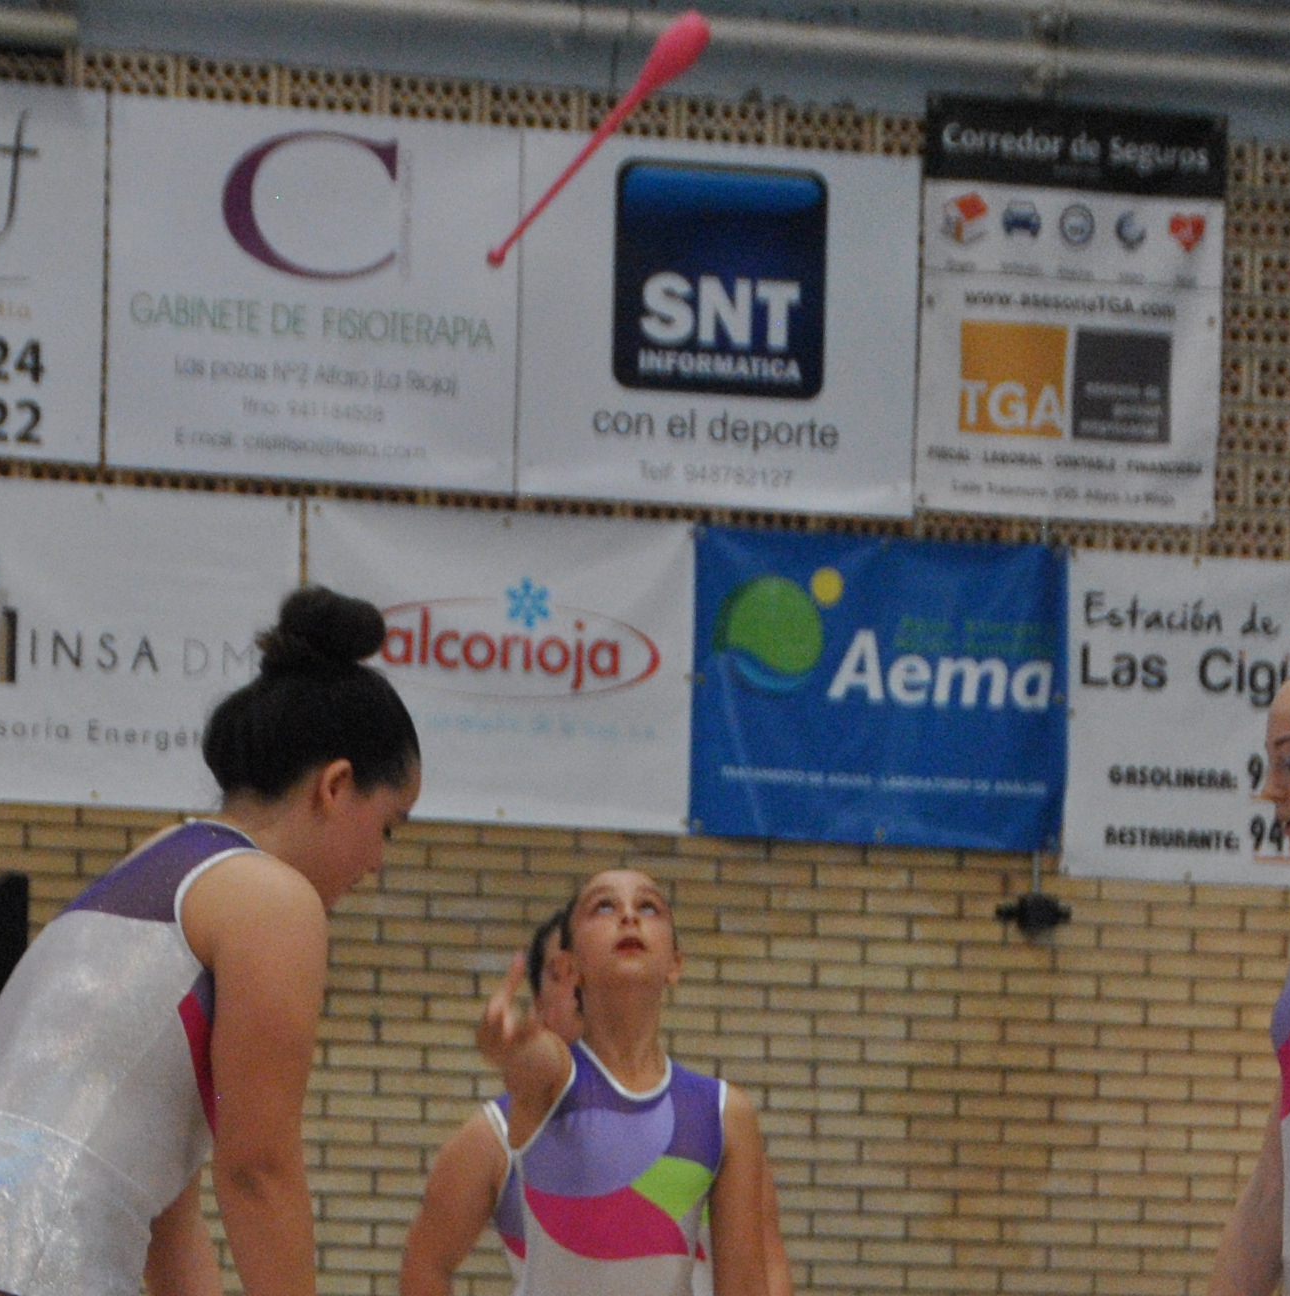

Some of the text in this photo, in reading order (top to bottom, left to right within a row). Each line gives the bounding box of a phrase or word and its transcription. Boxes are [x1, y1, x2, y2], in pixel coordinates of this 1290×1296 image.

[941, 121, 1209, 177] Corredor de Seguros
[129, 291, 494, 351] GABINETE DE FISIOTERAPIA
[639, 270, 802, 351] SNT
[637, 347, 803, 384] INFORMATICA
[959, 380, 1064, 428] TGA
[593, 407, 840, 451] con el deporte
[1084, 591, 1222, 633] Estación
[1241, 603, 1279, 637] de
[29, 628, 159, 674] INSA
[381, 606, 621, 690] alcorioja
[828, 628, 1053, 708] Aema
[1079, 643, 1168, 689] Las
[86, 718, 204, 751] Energét
[1109, 764, 1238, 790] GASOLINERA:
[1105, 814, 1284, 852] RESTAURANTE: 94
